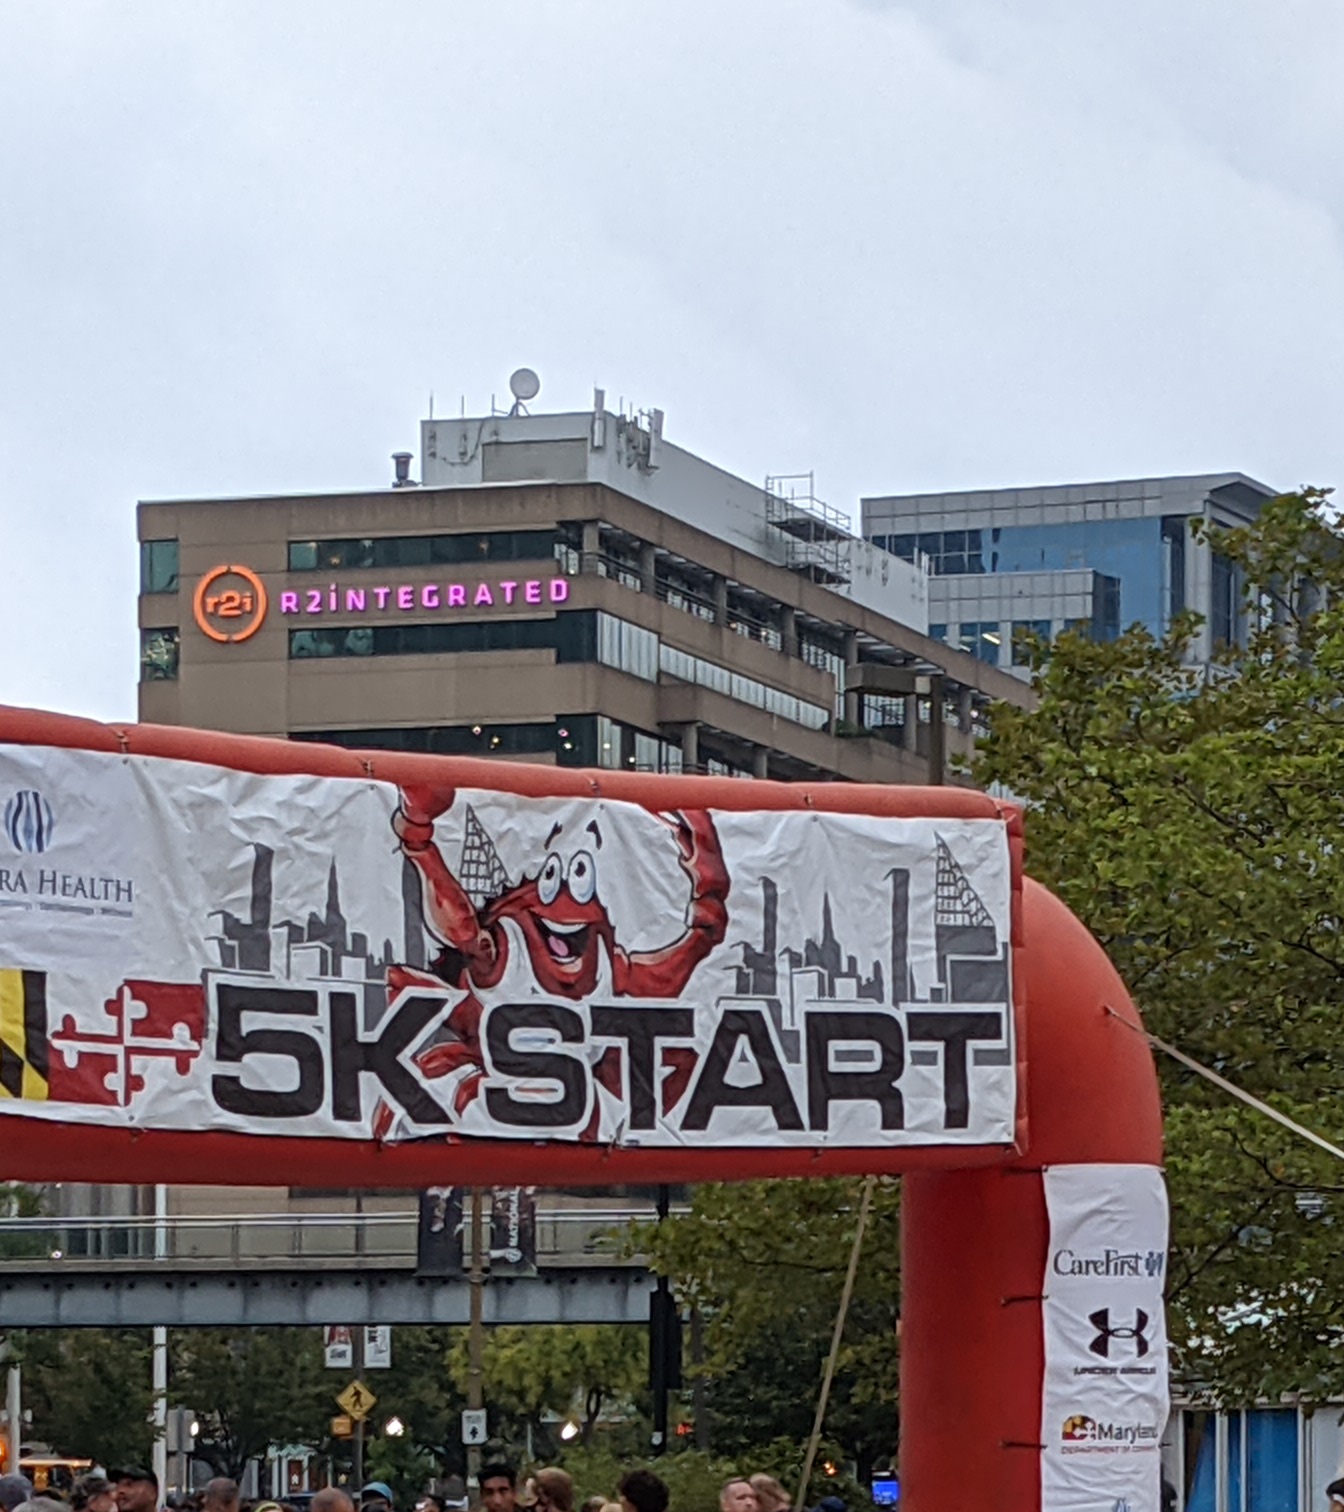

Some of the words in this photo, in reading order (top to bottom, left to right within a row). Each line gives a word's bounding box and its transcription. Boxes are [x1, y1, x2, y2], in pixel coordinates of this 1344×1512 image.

[38, 869, 133, 902] HEALTH
[484, 1003, 1002, 1132] START
[1053, 1249, 1143, 1277] CareFirst
